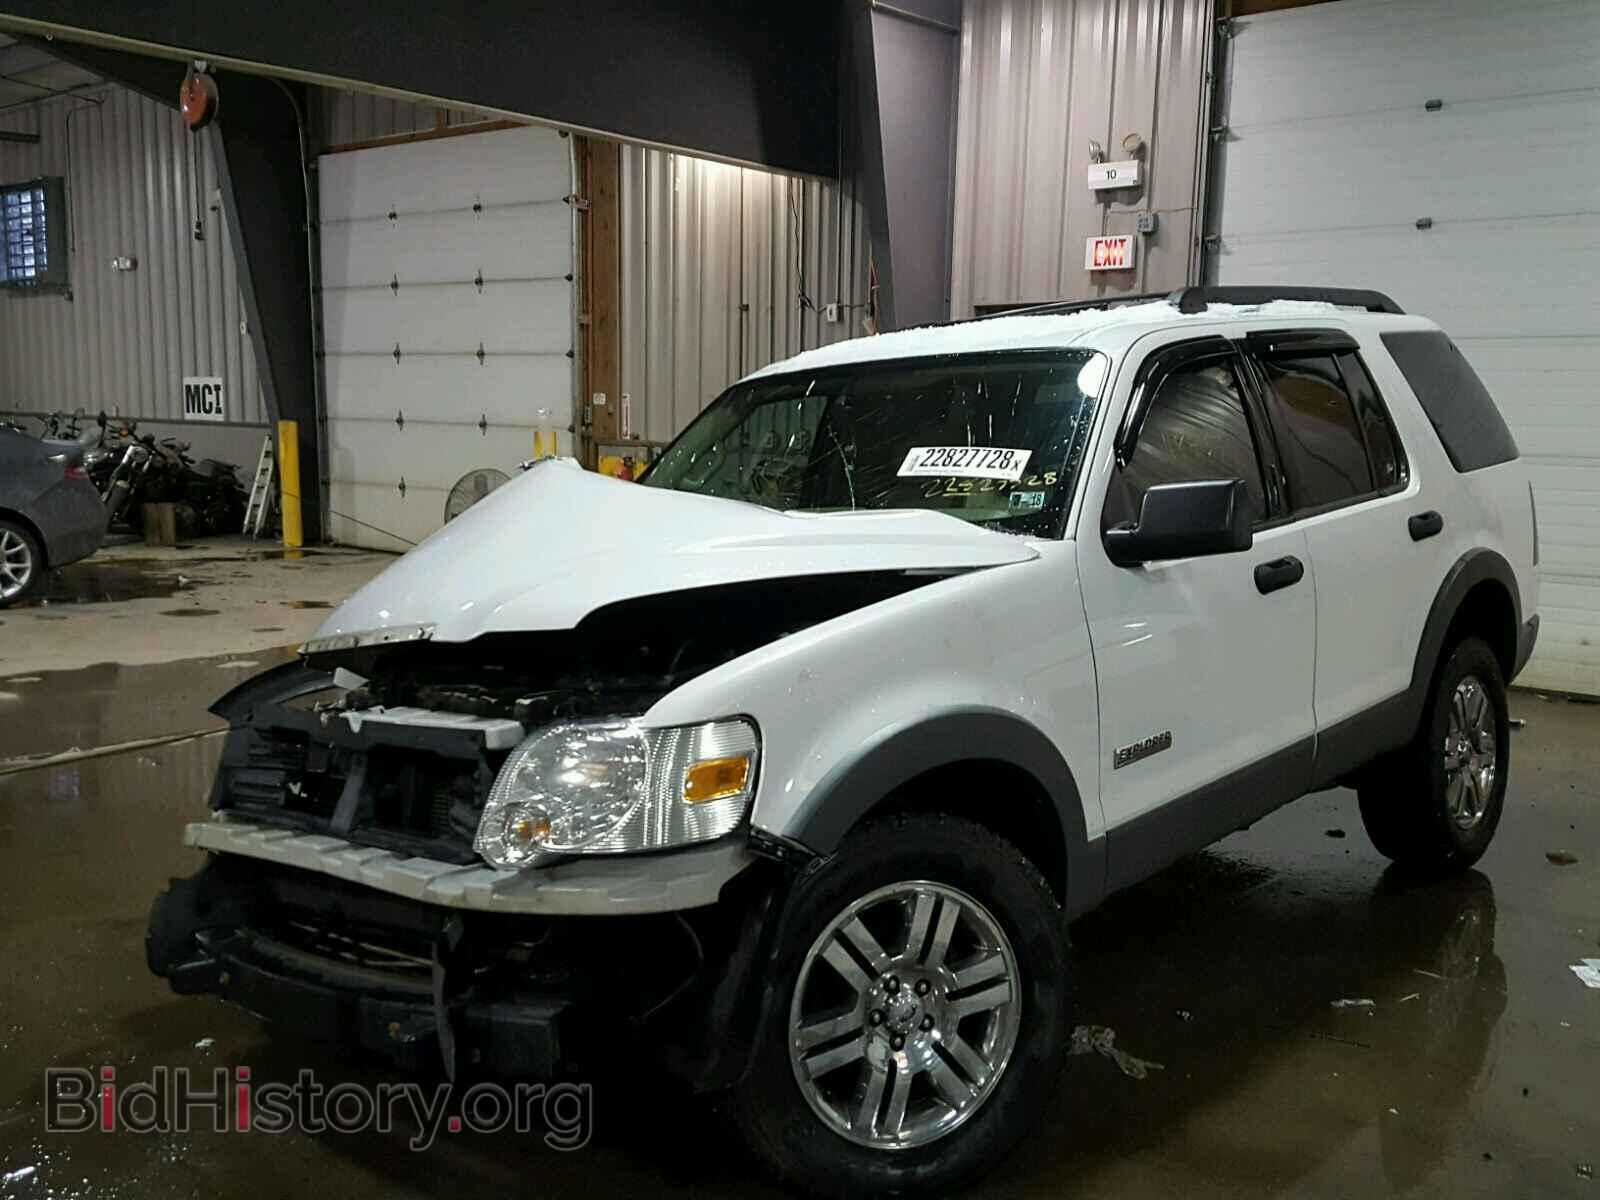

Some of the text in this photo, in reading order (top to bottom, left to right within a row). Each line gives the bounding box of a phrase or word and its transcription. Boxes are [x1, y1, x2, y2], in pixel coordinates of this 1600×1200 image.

[1106, 169, 1117, 180] 10
[1093, 239, 1126, 267] EXIT
[185, 383, 222, 414] MCI
[919, 448, 1015, 470] 22827728
[1119, 730, 1171, 761] EXPLORER
